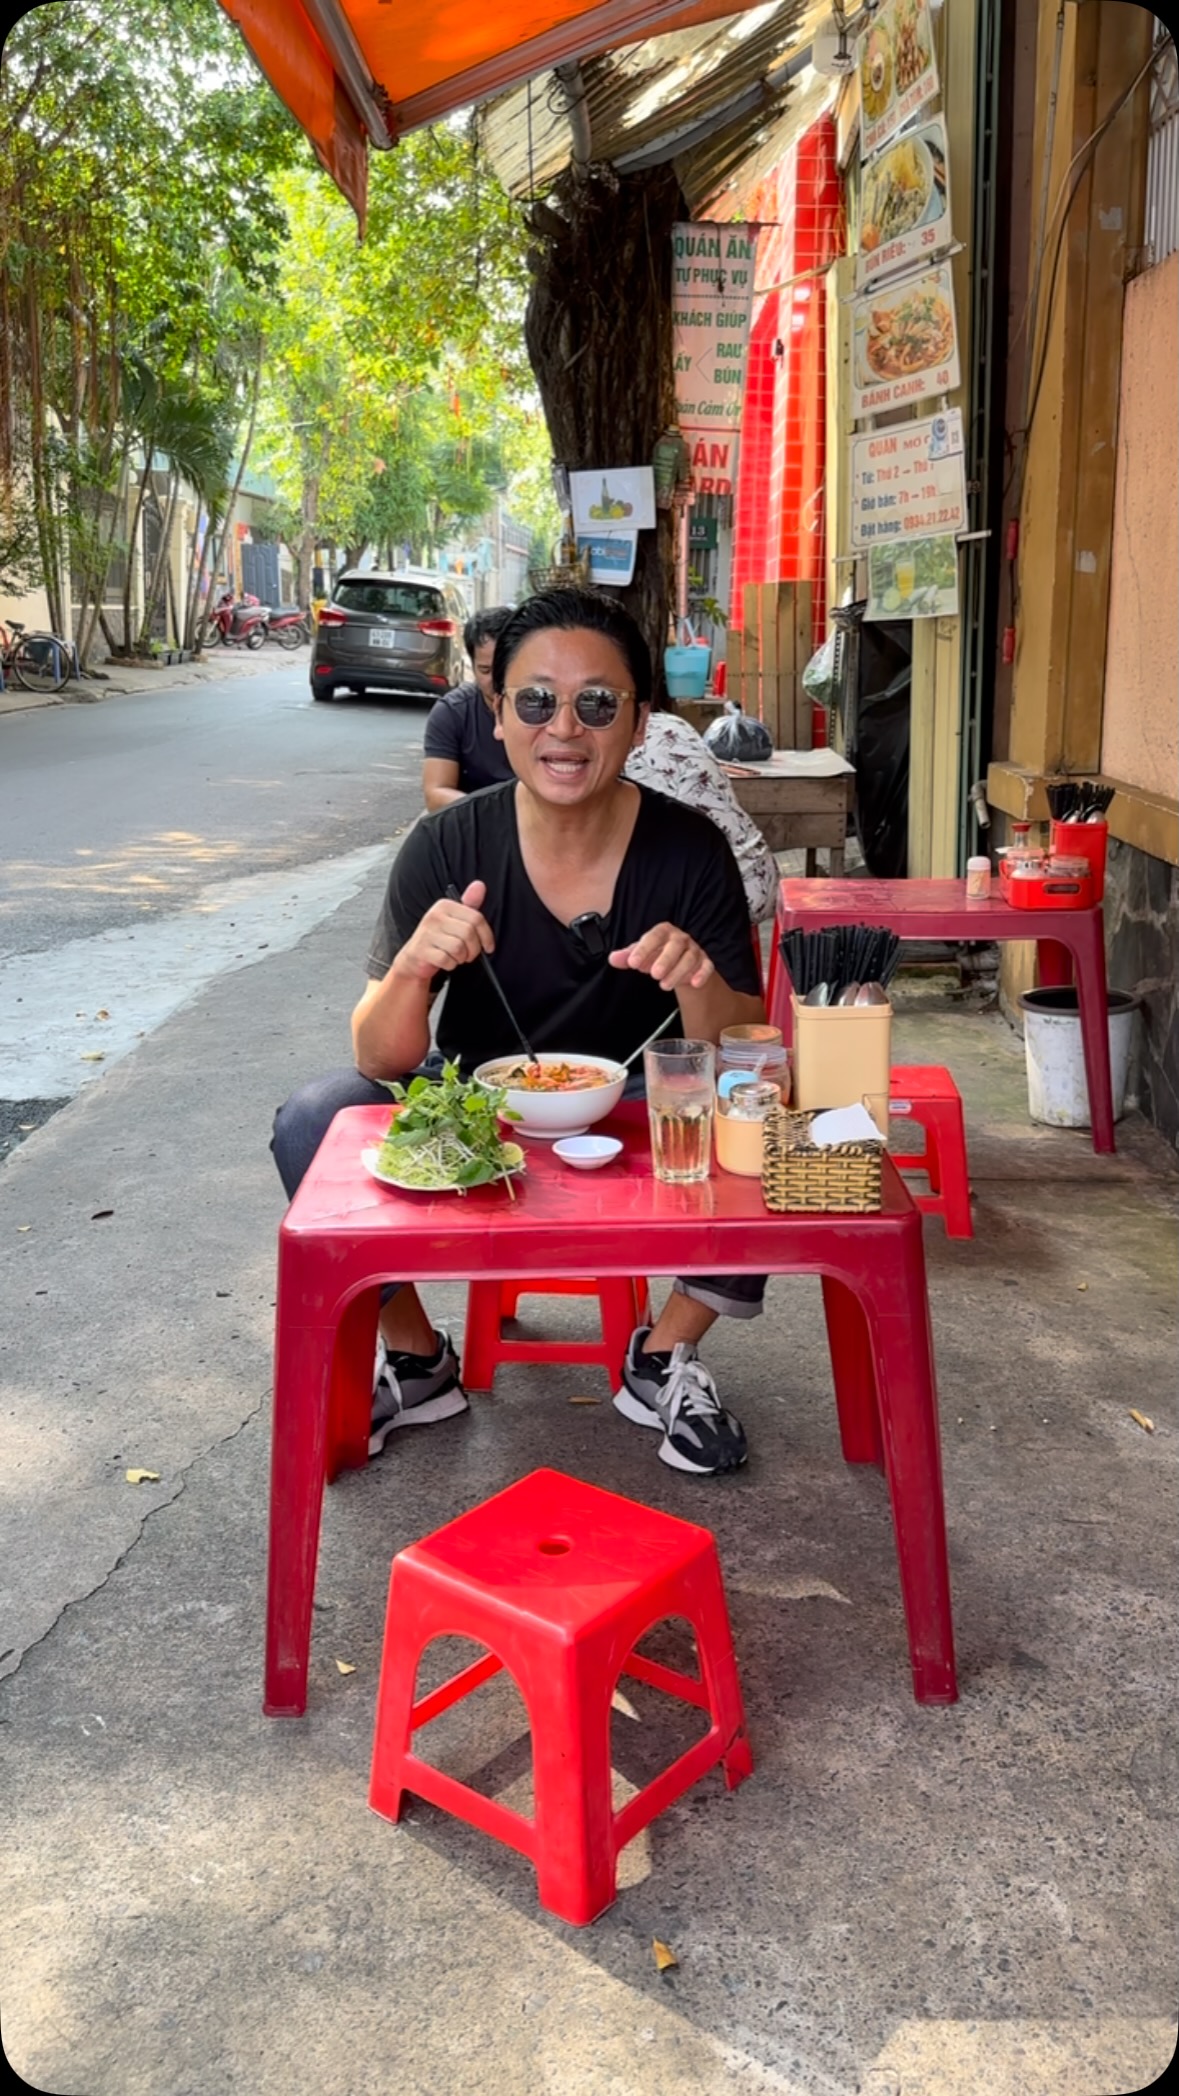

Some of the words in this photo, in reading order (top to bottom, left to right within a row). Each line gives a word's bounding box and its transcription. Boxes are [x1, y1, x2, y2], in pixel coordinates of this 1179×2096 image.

[674, 233, 720, 259] QUÁN
[726, 235, 751, 259] ĂN
[921, 228, 935, 246] 35
[675, 267, 691, 286] TỰ
[693, 268, 727, 287] PHỤC
[731, 270, 748, 288] VỤ
[716, 310, 747, 328] GIÚP
[716, 343, 742, 358] RAU
[714, 366, 742, 384] BÚN
[894, 465, 899, 479] 2
